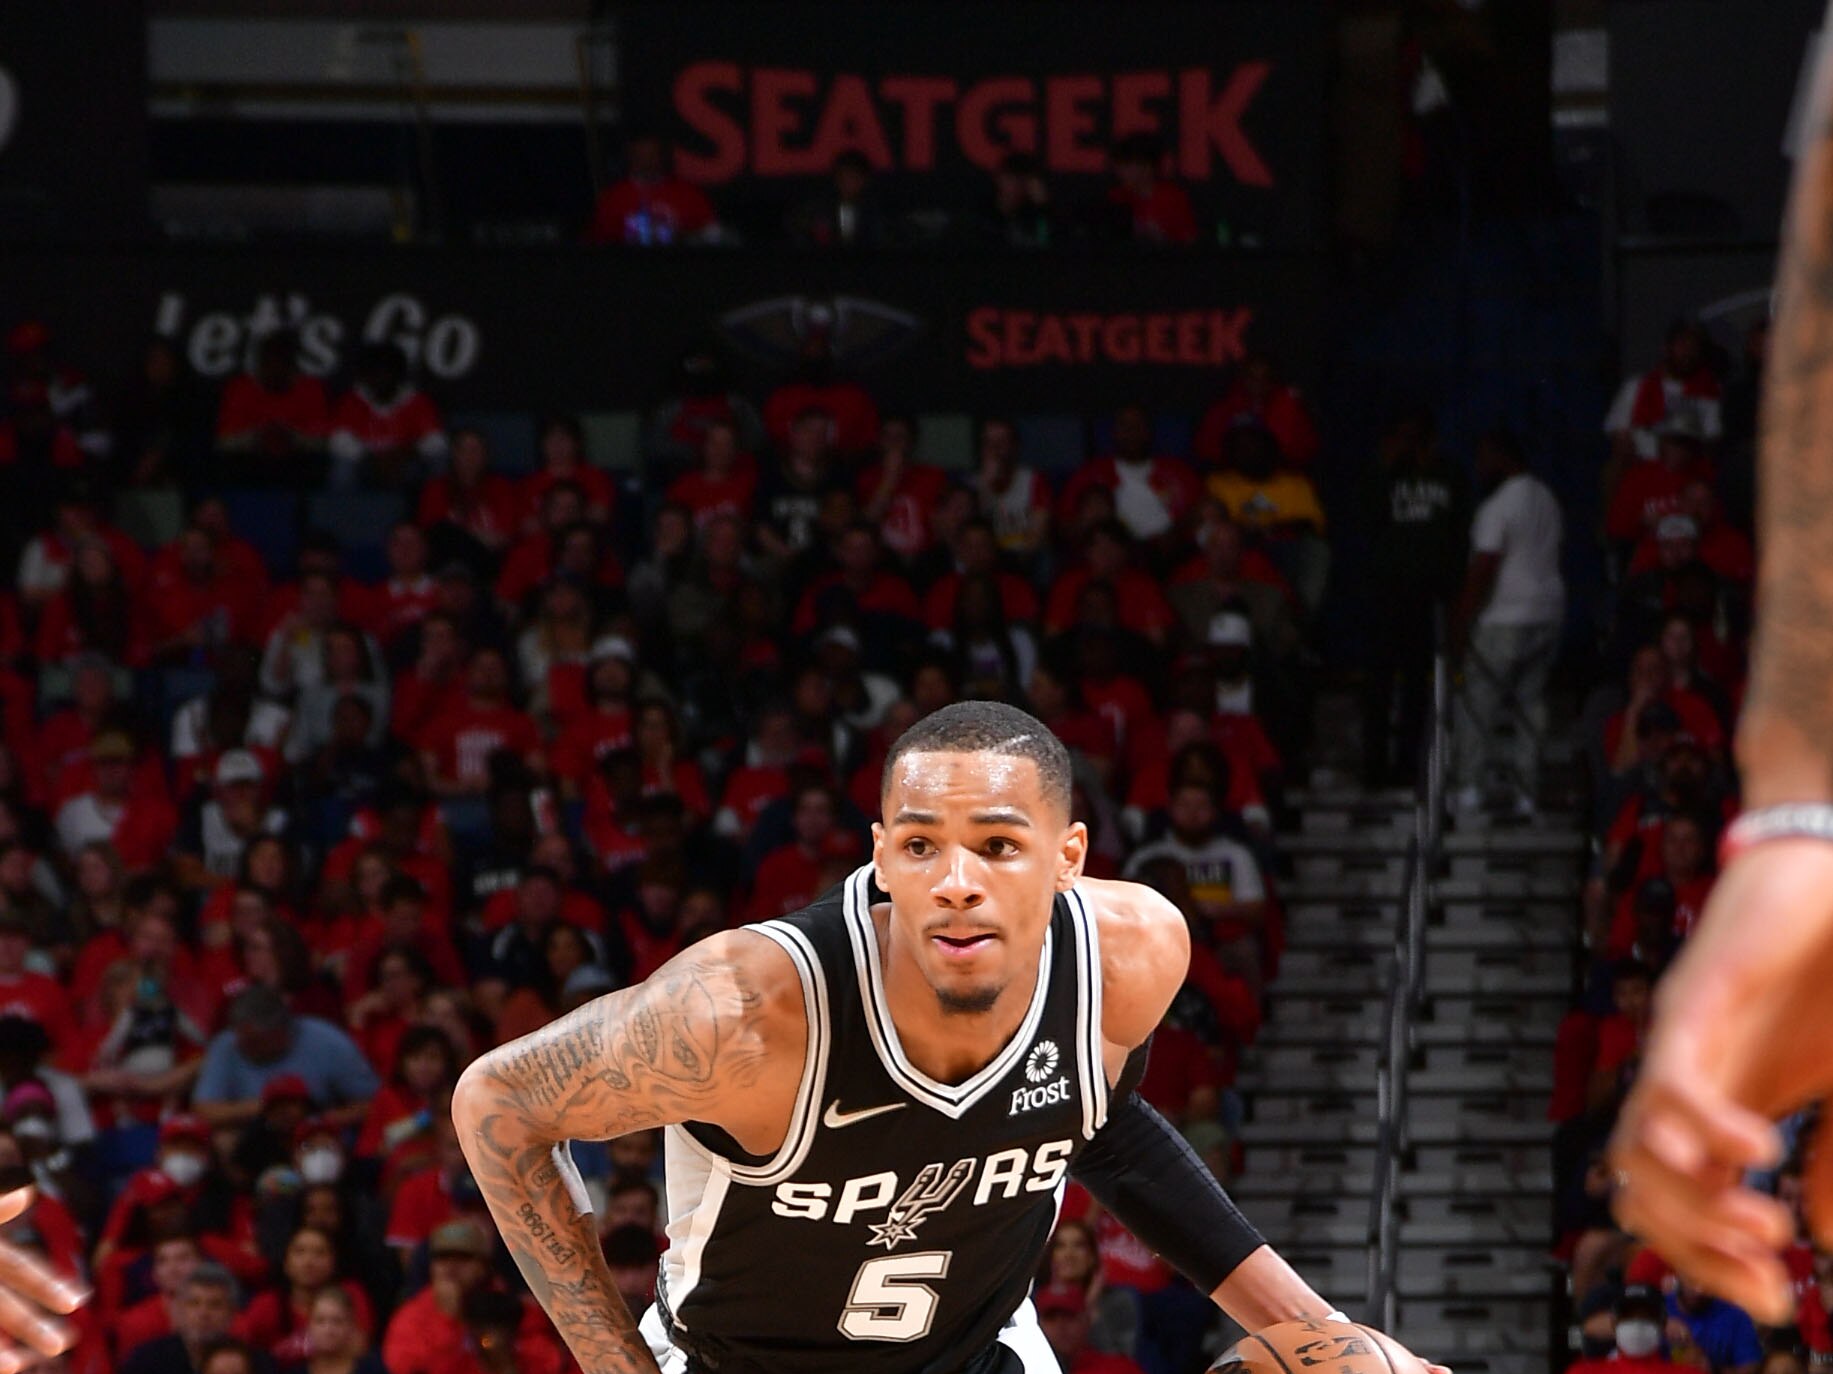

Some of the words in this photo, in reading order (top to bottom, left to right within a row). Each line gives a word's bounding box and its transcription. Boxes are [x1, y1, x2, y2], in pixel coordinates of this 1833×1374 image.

[672, 60, 1274, 188] SEATGEEK
[965, 308, 1252, 368] SEATGEEK
[1008, 1075, 1071, 1117] Frost
[771, 1139, 1073, 1249] SPURS
[836, 1250, 953, 1343] 5
